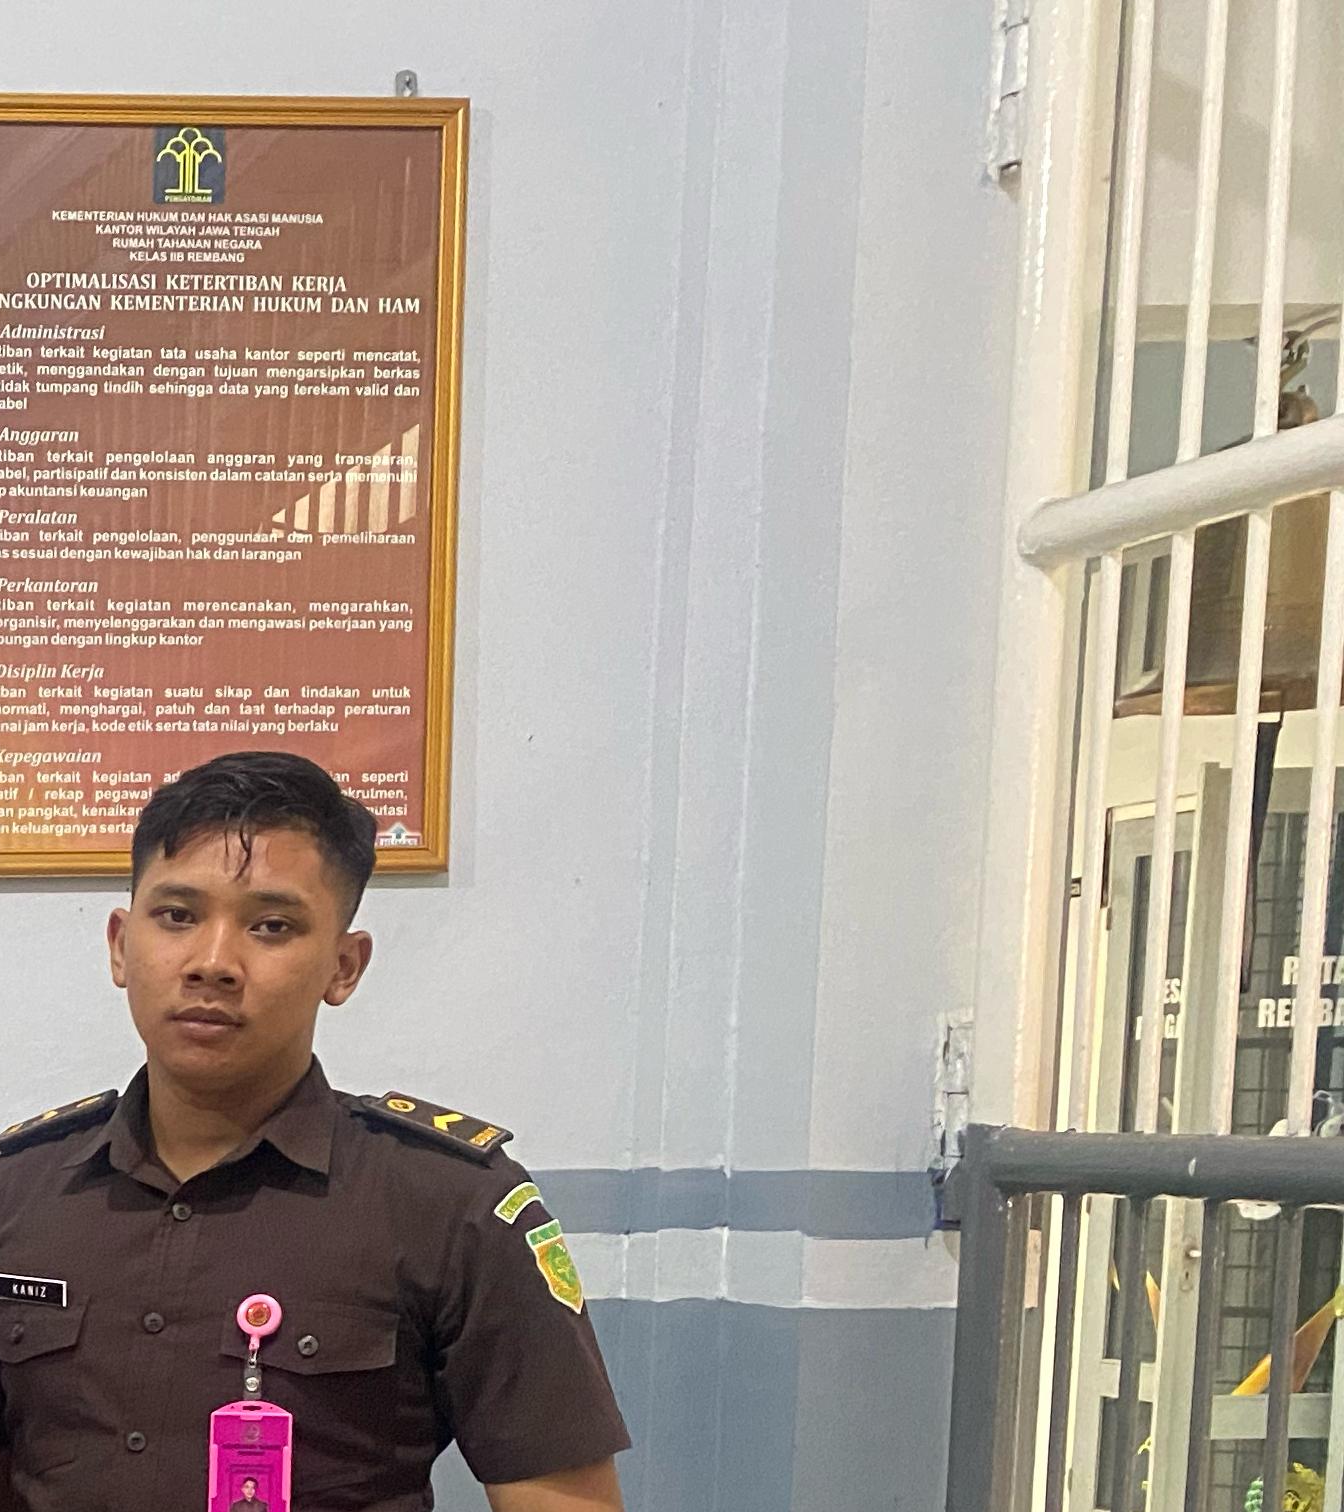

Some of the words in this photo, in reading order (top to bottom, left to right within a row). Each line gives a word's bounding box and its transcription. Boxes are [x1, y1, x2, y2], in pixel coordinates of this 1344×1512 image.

[52, 210, 134, 222] KEMENTERIAN
[137, 212, 179, 223] HUKUM
[181, 212, 205, 222] DAN
[208, 212, 232, 223] HAK
[234, 213, 269, 223] ASASI
[272, 213, 323, 224] MANUSIA
[95, 224, 143, 235] KANTOR
[146, 225, 196, 236] WILAYAH
[198, 225, 231, 236] JAWA
[232, 226, 280, 236] TENGAH
[113, 237, 154, 249] RUMAH
[156, 237, 211, 249] TAHANAN
[214, 239, 262, 250] NEGARA
[129, 251, 167, 262] KELAS
[170, 251, 184, 262] IIB
[187, 252, 245, 263] REMBANG
[27, 272, 156, 290] OPTIMALISASI
[166, 274, 282, 291] KETERTIBAN
[292, 276, 346, 295] KERJA
[110, 294, 244, 312] KEMENTERIAN
[254, 296, 322, 313] HUKUM
[331, 297, 368, 313] DAN
[379, 298, 420, 314] HAM
[0, 324, 105, 340] Administrasi
[60, 664, 104, 682] Kerja
[94, 685, 153, 701] kegiatan
[164, 686, 203, 698] suatu
[215, 685, 252, 701] sikap
[264, 685, 289, 698] dan
[372, 686, 411, 700] untuk
[12, 1284, 47, 1298] KANIZ
